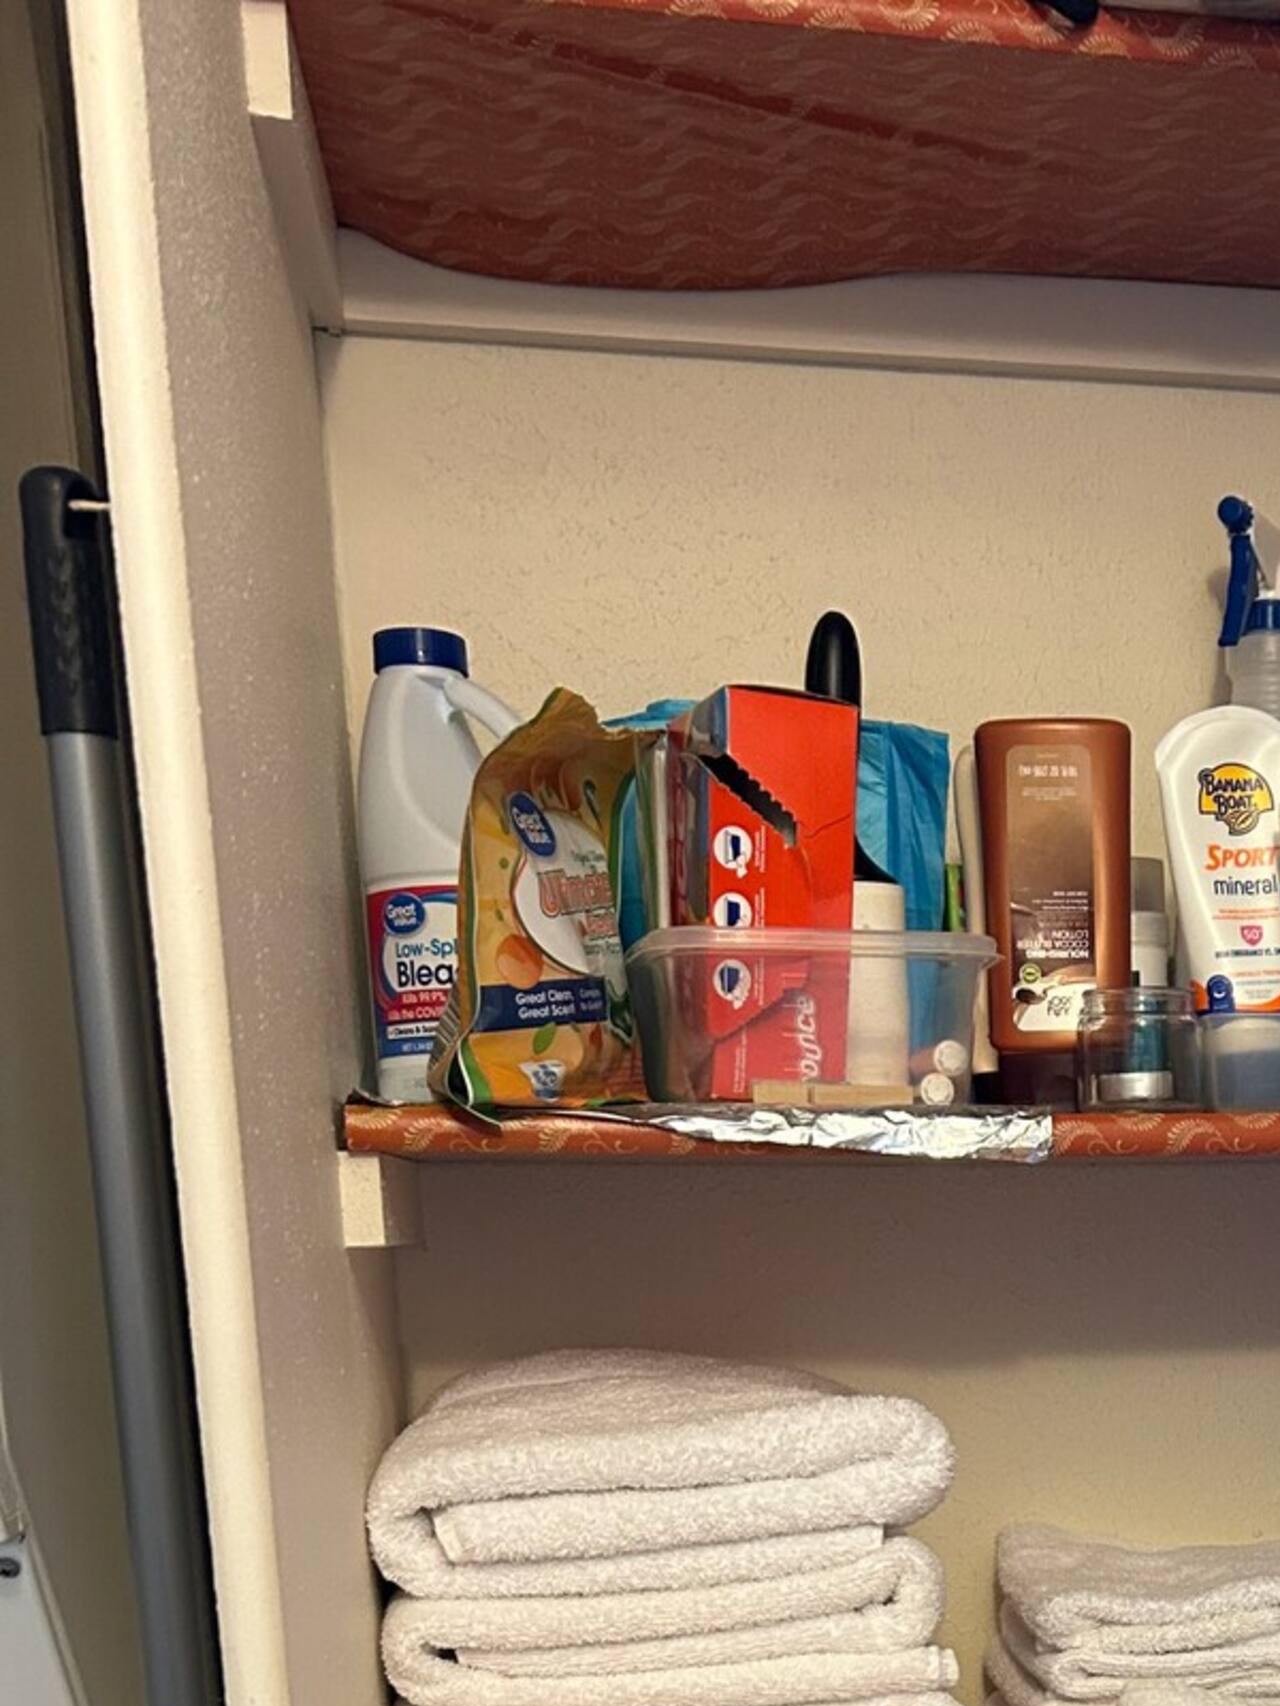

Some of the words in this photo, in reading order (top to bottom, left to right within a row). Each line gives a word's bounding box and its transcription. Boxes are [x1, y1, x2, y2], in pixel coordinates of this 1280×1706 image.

[1200, 771, 1264, 796] BANANA
[1205, 844, 1280, 871] SPORT
[1213, 874, 1278, 895] mineral
[386, 903, 417, 920] Great
[395, 938, 459, 959] Low-Spl
[396, 961, 459, 988] Blea
[515, 991, 547, 1005] Great
[518, 1005, 549, 1019] Great
[797, 997, 823, 1082] ounce
